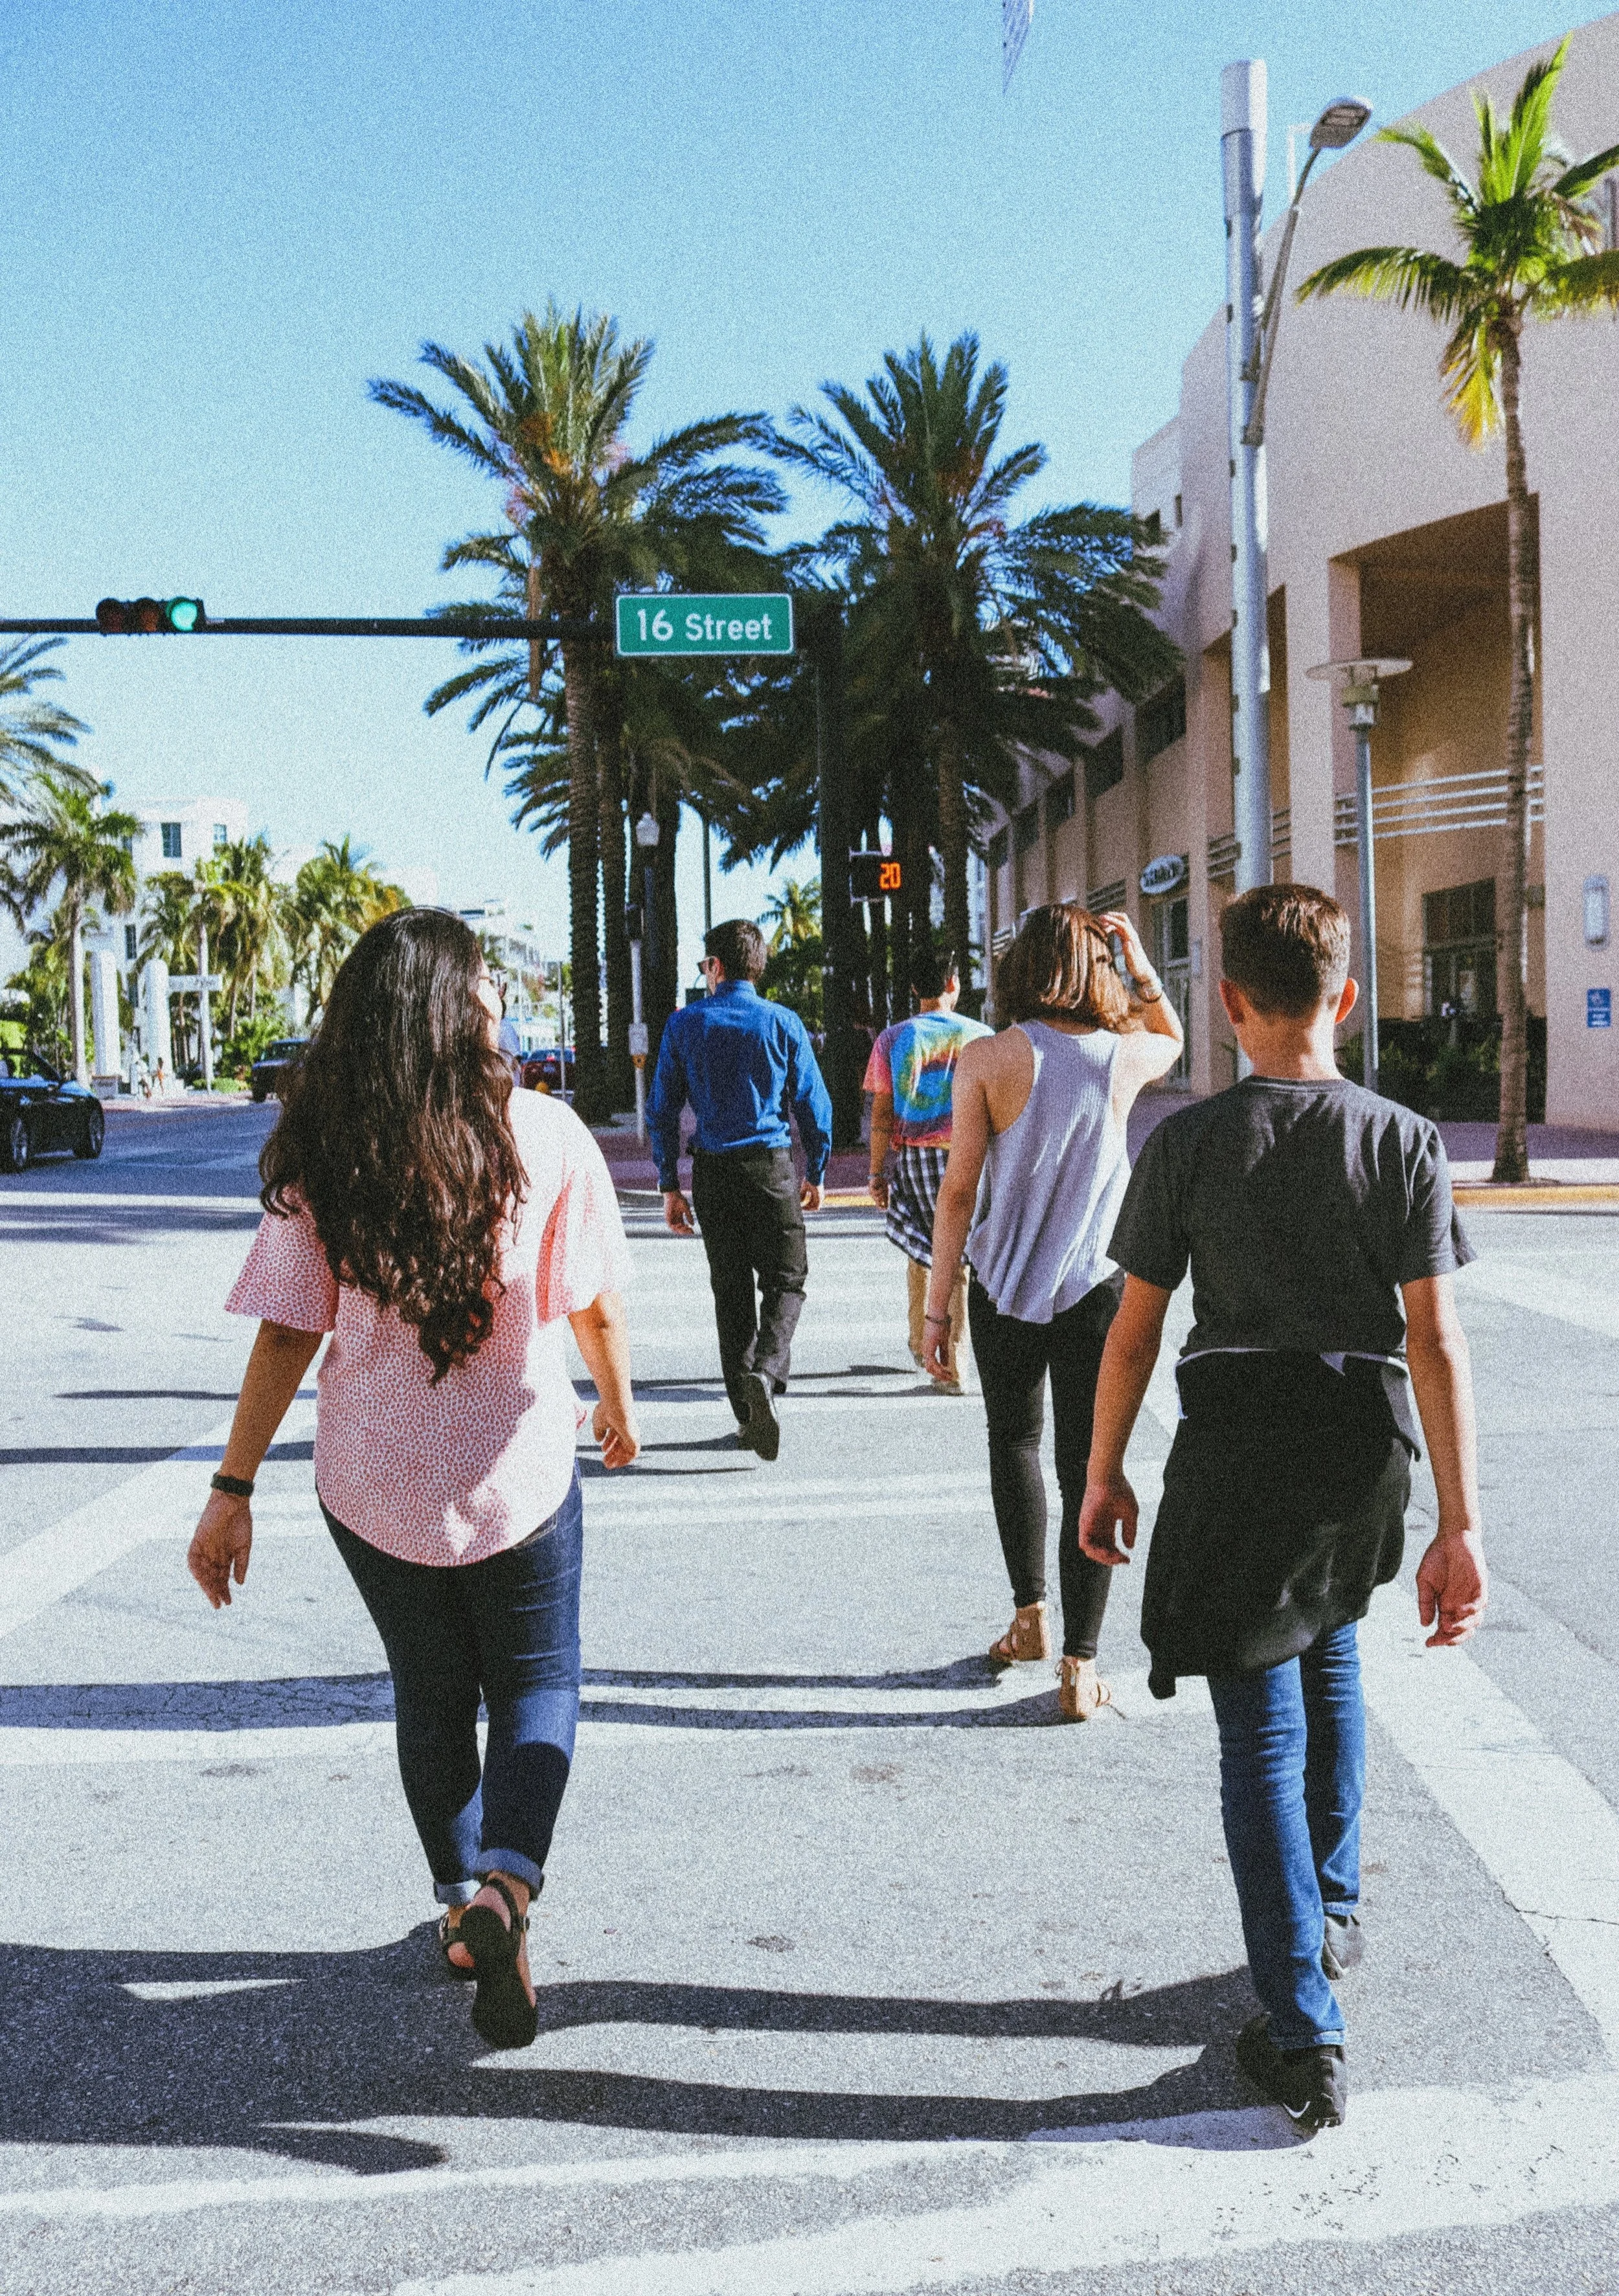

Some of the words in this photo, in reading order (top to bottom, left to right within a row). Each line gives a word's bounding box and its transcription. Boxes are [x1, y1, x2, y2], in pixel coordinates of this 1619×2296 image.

[637, 609, 674, 641] 16
[685, 613, 773, 641] Street
[879, 862, 901, 889] 20
